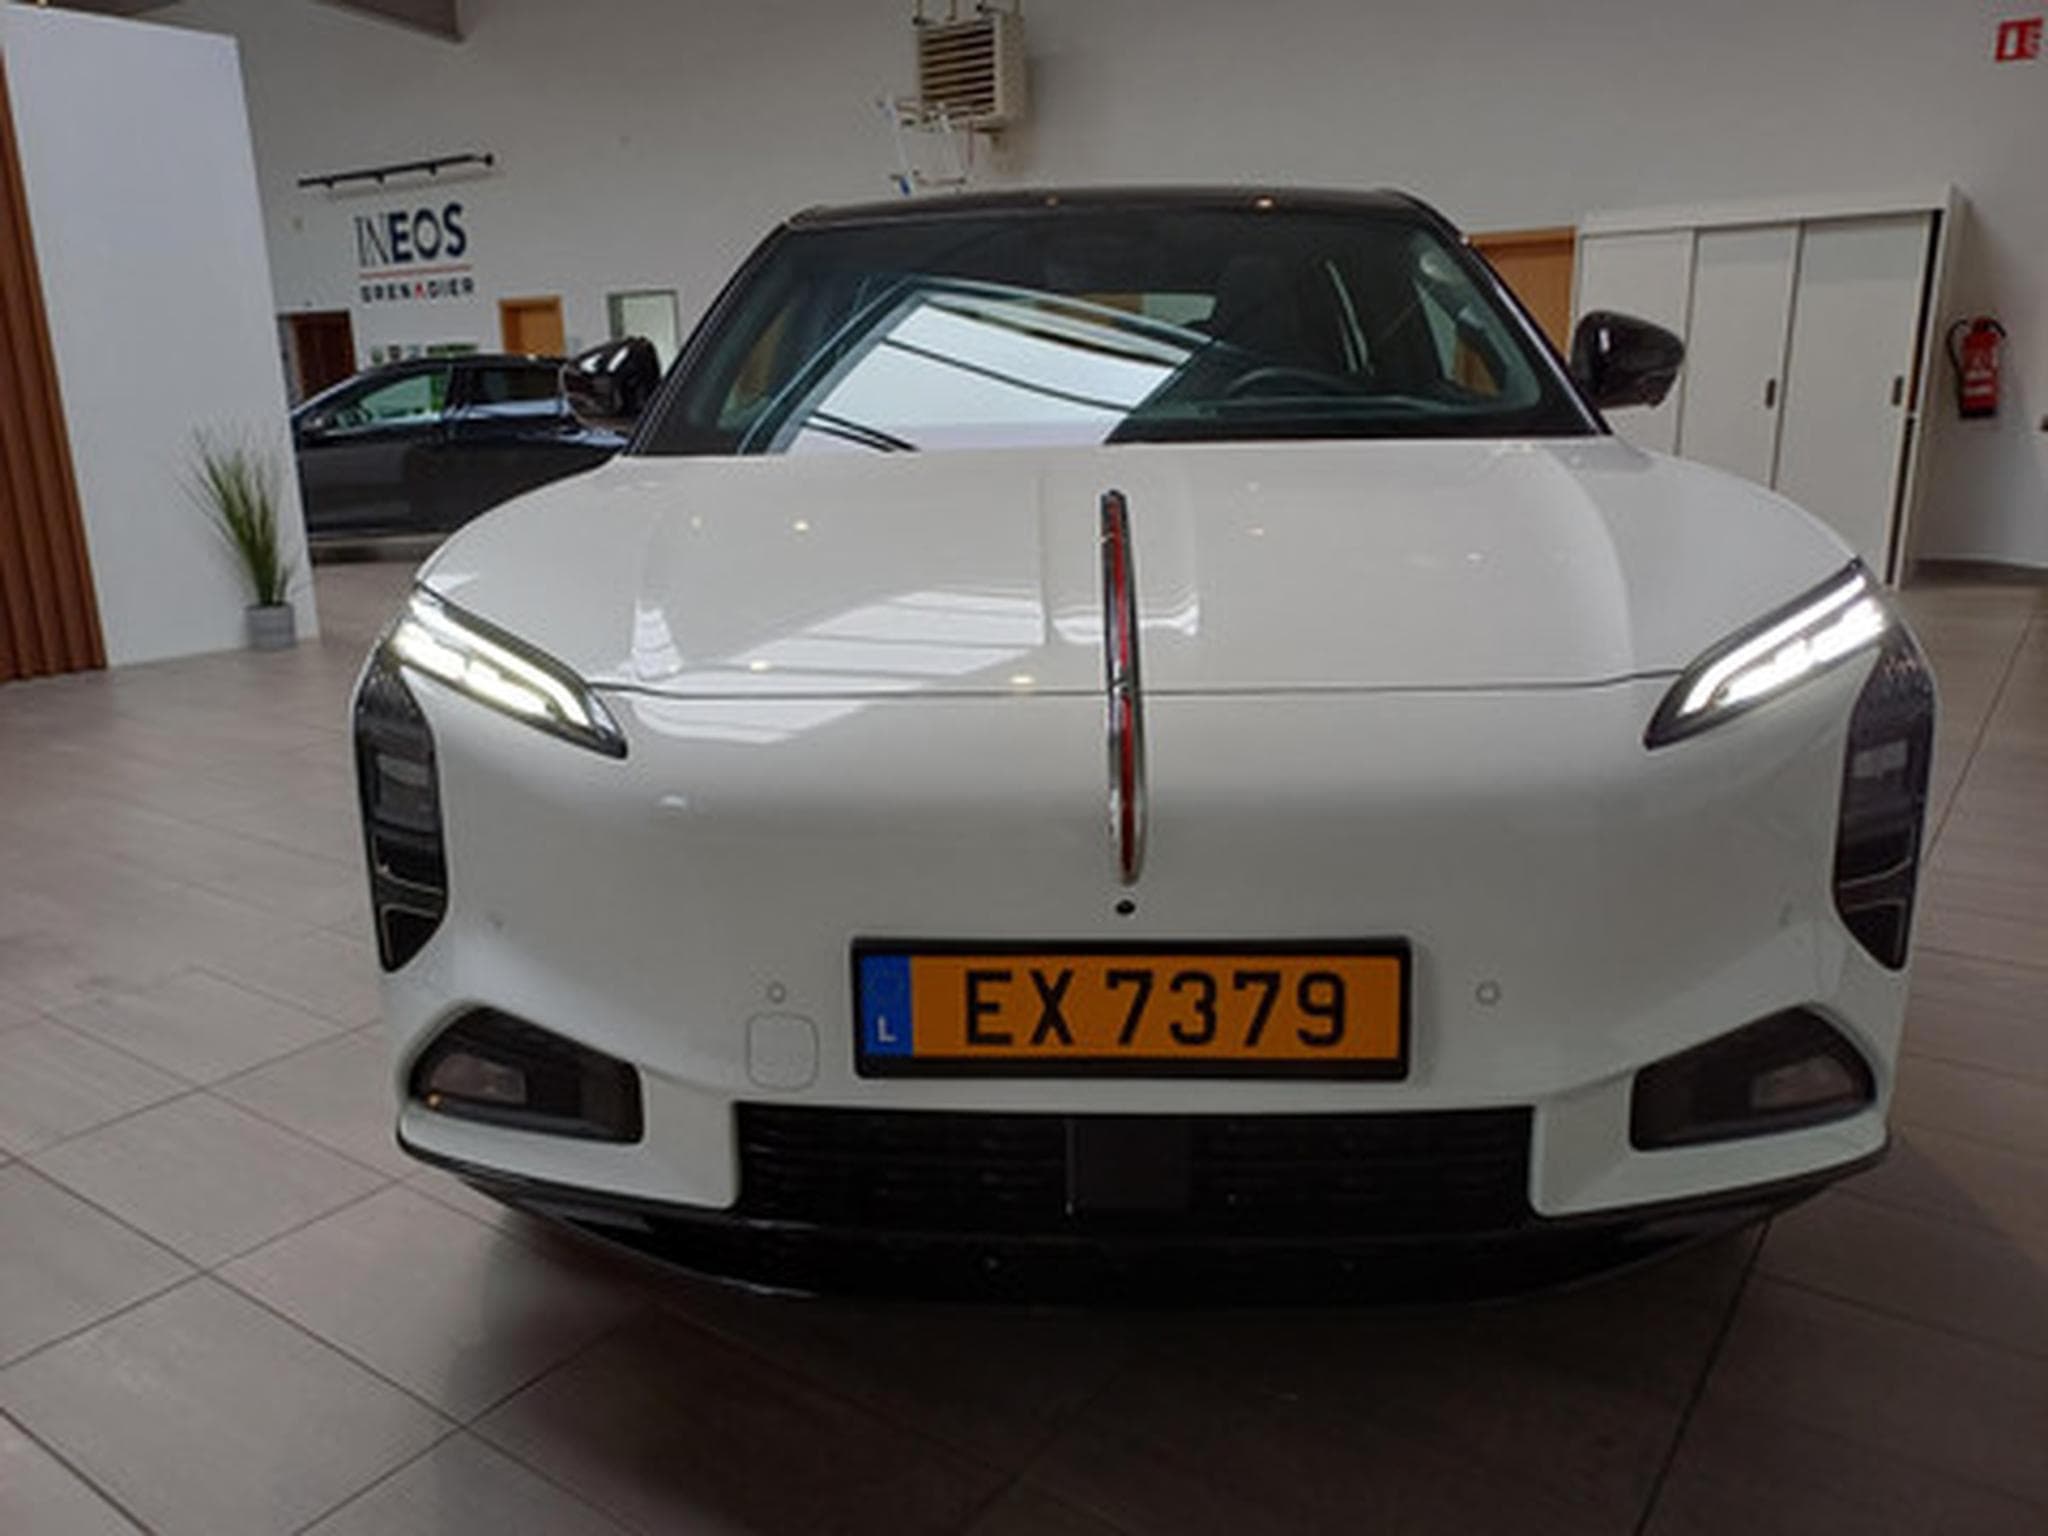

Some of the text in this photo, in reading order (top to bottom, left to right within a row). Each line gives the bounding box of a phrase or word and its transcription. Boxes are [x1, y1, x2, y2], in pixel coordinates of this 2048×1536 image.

[354, 202, 467, 266] INEOS
[360, 277, 475, 303] GRENADIER
[877, 1015, 897, 1043] L
[965, 968, 1347, 1048] EX 7379
